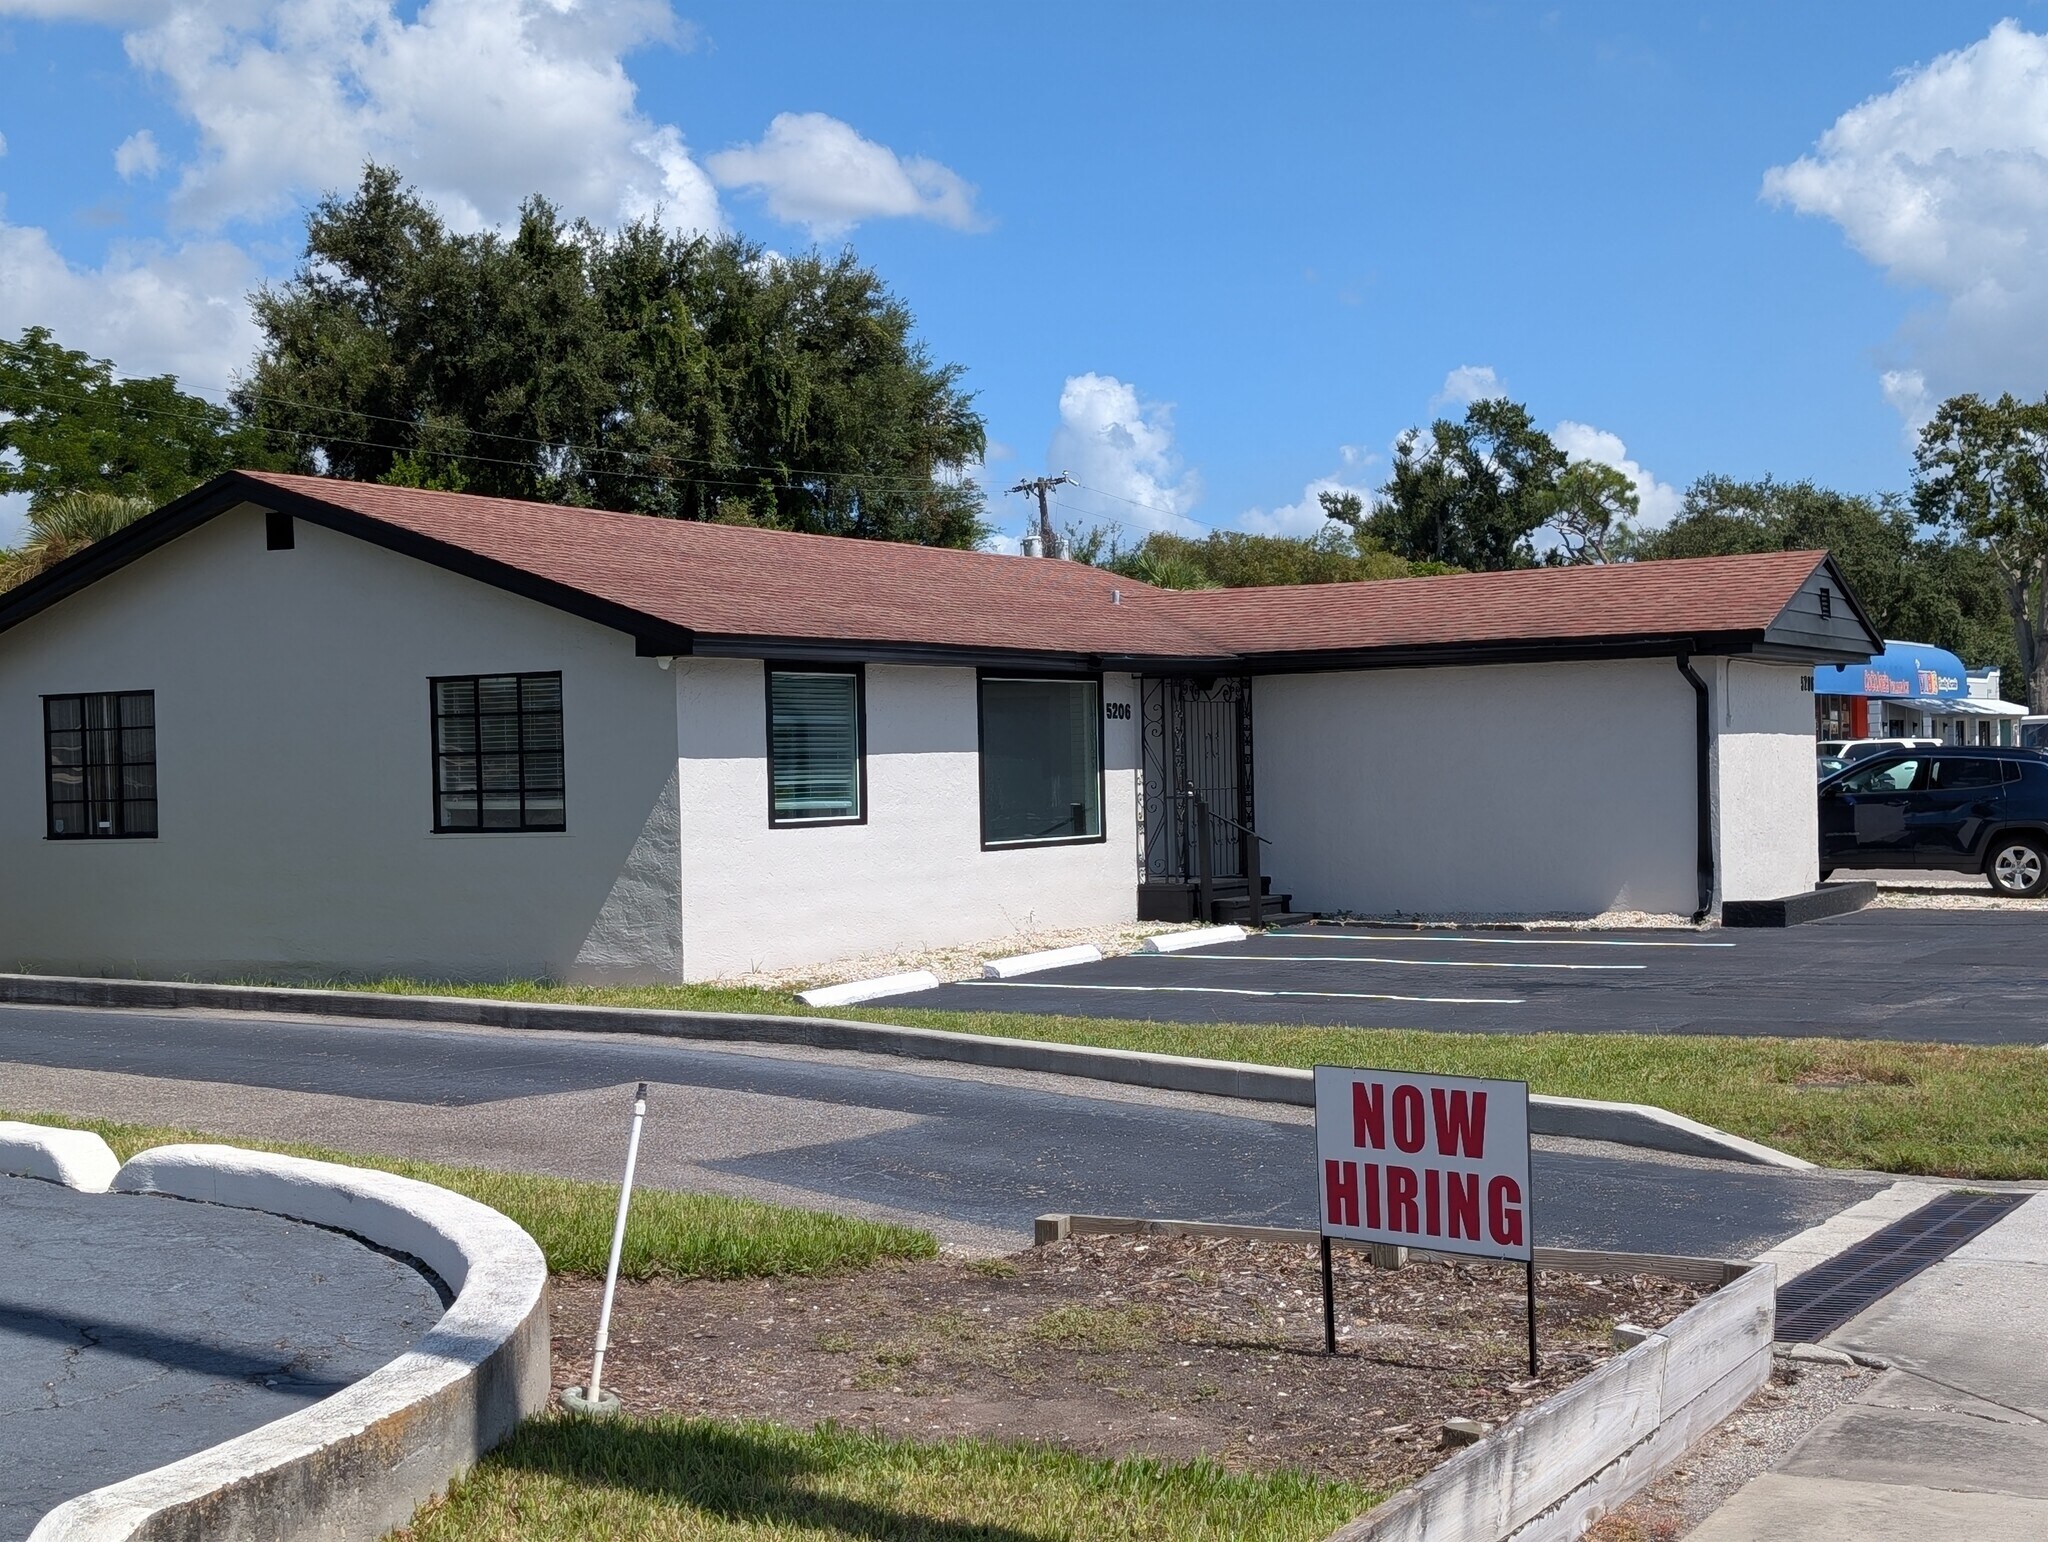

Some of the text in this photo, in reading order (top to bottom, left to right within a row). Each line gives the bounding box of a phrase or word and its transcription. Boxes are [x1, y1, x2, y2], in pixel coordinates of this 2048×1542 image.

[1106, 702, 1131, 720] 5206
[1352, 1082, 1487, 1159] NOW
[1325, 1159, 1523, 1247] HIRING
